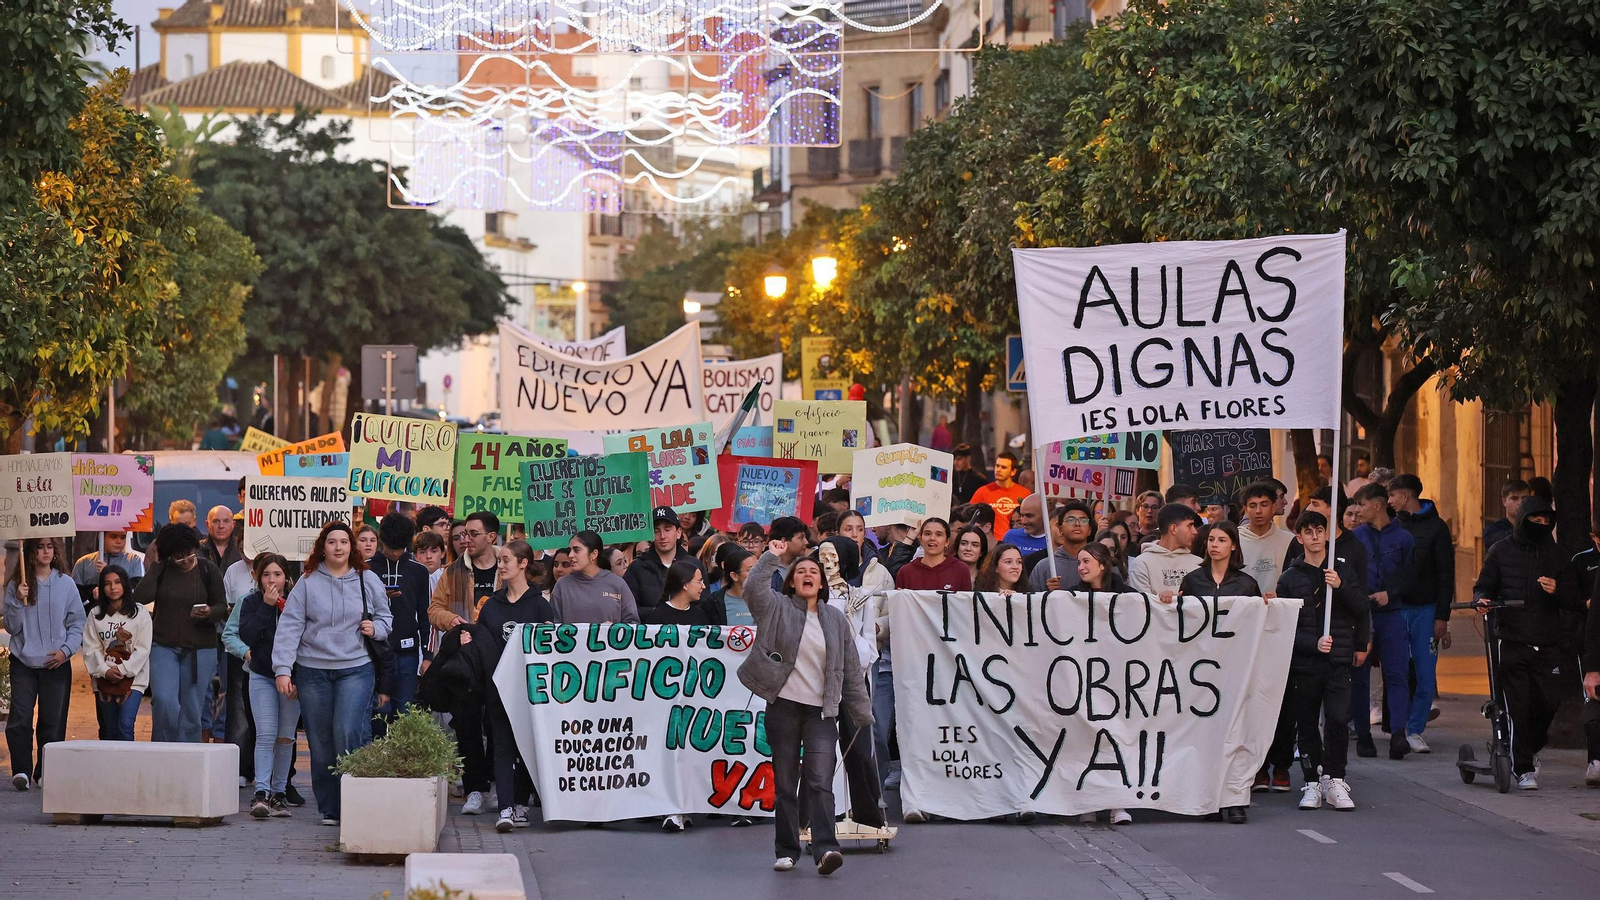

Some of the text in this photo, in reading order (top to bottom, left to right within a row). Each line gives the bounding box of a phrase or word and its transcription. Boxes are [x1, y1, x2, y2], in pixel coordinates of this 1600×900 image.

[1073, 246, 1302, 329] AULAS
[1062, 327, 1295, 405] DIGNAS
[517, 345, 692, 414] EDIFICIO YA
[517, 377, 626, 416] NUEVO
[795, 405, 845, 425] edificio
[1081, 395, 1286, 433] IES LOLA FLORES
[353, 415, 457, 452] ¡QUIERO
[628, 428, 694, 452] EL LOLA
[737, 434, 757, 449] MÁS
[800, 430, 833, 440] nuevo
[1181, 430, 1256, 453] HARTOS
[470, 438, 566, 470] 14 AÑOS
[876, 446, 928, 466] Cumplir
[1125, 431, 1158, 462] NO
[376, 447, 411, 473] MI
[529, 457, 605, 482] QUEREMOS
[1190, 452, 1271, 477] DE ESTAR
[16, 476, 53, 492] Lola
[349, 467, 449, 498] EDIFICIO YA!
[649, 469, 664, 485] SE
[742, 467, 779, 481] NUEVO
[79, 478, 133, 497] Nuevo
[249, 484, 347, 503] QUEREMOS AULAS
[526, 475, 633, 502] QUE SE CUMPLE
[1198, 480, 1227, 498] SIN
[21, 494, 68, 510] VOSOTROS
[88, 498, 123, 516] Ya!!
[555, 498, 612, 518] LA LEY
[877, 497, 926, 515] Promesa
[249, 508, 350, 528] NO CONTENEDORES
[532, 519, 578, 539] AULAS
[937, 590, 1235, 647] INICIO DE
[521, 623, 577, 655] IES
[586, 623, 679, 652] LOLA
[526, 655, 726, 705] EDIFICIO
[926, 653, 1220, 721] LAS OBRAS
[561, 717, 633, 736] POR UNA
[938, 725, 978, 744] IES
[554, 733, 648, 754] EDUCACIÓN
[567, 752, 634, 773] PÚBLICA
[932, 749, 969, 764] LOLA
[1014, 725, 1166, 801] YA!!
[558, 771, 651, 792] DE CALIDAD
[945, 763, 1003, 780] FLORES
